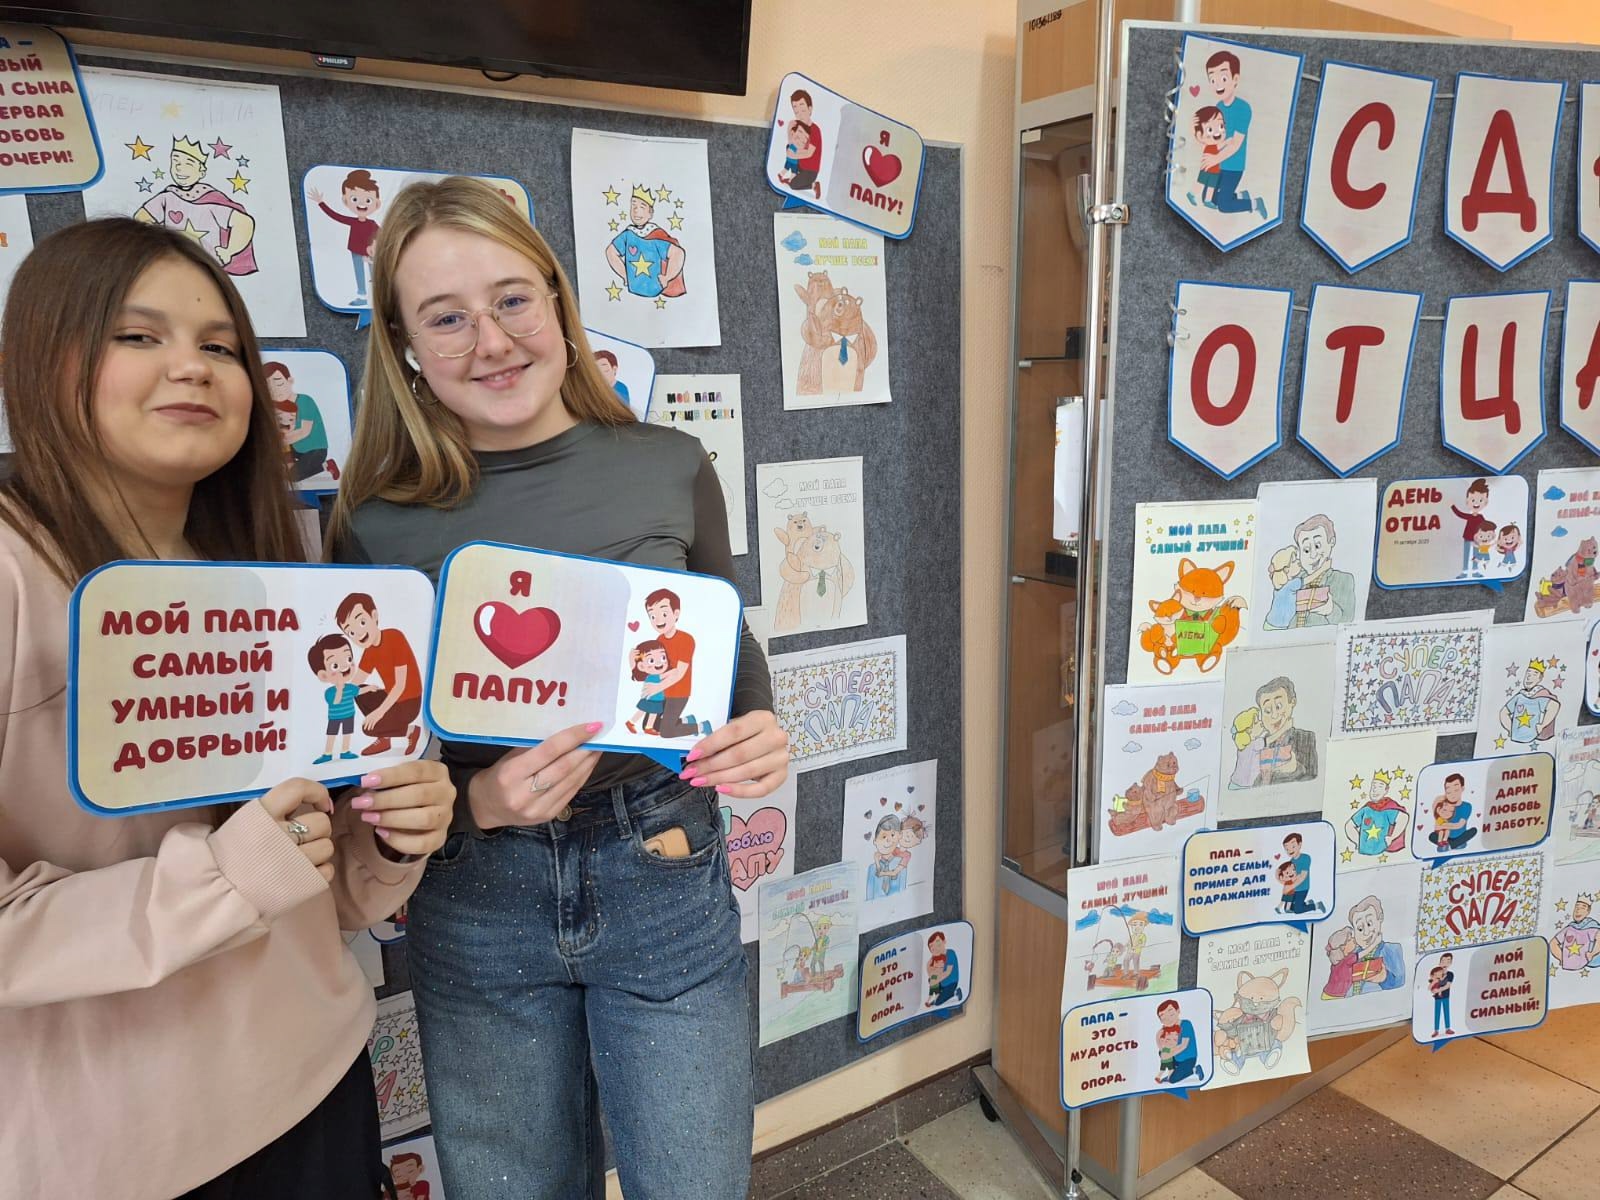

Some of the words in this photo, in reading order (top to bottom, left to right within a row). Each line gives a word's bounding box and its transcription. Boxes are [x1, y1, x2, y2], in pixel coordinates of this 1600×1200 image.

[0, 53, 43, 72] ВЫЙ
[12, 80, 74, 96] СЫНА
[0, 104, 64, 120] ЕРВАЯ
[880, 130, 891, 147] Я
[0, 150, 74, 166] ОЧЕРИ!
[1330, 102, 1396, 210] С
[850, 183, 903, 215] ПАПУ!
[694, 392, 722, 403] ПАПА
[1388, 488, 1443, 508] ДЕНЬ
[1169, 523, 1193, 536] МОЙ
[1198, 524, 1227, 535] ПАПА
[1385, 515, 1440, 533] ОТЦА
[1150, 540, 1191, 554] САМЫЙ
[1197, 538, 1248, 552] ЛУЧШИЙ!
[509, 570, 532, 597] Я
[101, 601, 189, 636] МОЙ
[204, 608, 299, 633] ПАПА
[133, 641, 273, 678] САМЫЙ
[1379, 644, 1458, 680] СУПЕР
[452, 672, 568, 707] ПАПУ!
[804, 671, 875, 709] СУПЕР
[1376, 669, 1456, 713] ПАПА
[111, 682, 253, 724] УМНЫЙ
[267, 689, 289, 712] И
[1143, 705, 1166, 718] МОЙ
[1170, 704, 1197, 715] ПАПА
[804, 694, 875, 741] ПАПА
[113, 721, 287, 773] ДОБРЫЙ!
[1501, 767, 1535, 781] ПАПА
[1495, 784, 1539, 800] ДАРИТ
[1489, 802, 1541, 816] ЛЮБОВЬ
[1482, 823, 1491, 833] И
[1494, 816, 1545, 832] ЗАБОТУ.
[1209, 848, 1241, 860] ПАПА
[730, 848, 785, 881] АПУ
[1189, 864, 1229, 877] ОПОРА
[1232, 860, 1272, 872] СЕМЬИ,
[1097, 877, 1118, 891] МОЙ
[1122, 873, 1148, 887] ПАПА
[1194, 877, 1239, 891] ПРИМЕР
[1242, 874, 1266, 886] ДЛЯ
[1448, 870, 1520, 904] СУПЕР
[1081, 893, 1118, 909] САМЫЙ
[1122, 884, 1168, 902] ЛУЧШИЙ!
[1188, 888, 1271, 907] ПОДРАЖАНИЯ!
[1445, 892, 1518, 935] ПАПА
[874, 948, 897, 965] ПАПА
[1228, 941, 1250, 955] МОЙ
[1494, 947, 1523, 965] МОЙ
[881, 962, 898, 976] ЭТО
[1489, 968, 1525, 982] ПАПА
[865, 970, 914, 999] МУДРОСТЬ
[1481, 981, 1531, 1000] САМЫЙ
[886, 992, 893, 1002] И
[871, 1002, 904, 1023] ОПОРА.
[1470, 997, 1540, 1019] СИЛЬНЫЙ!
[1081, 1012, 1114, 1027] ПАПА
[1091, 1027, 1116, 1040] ЭТО
[1070, 1040, 1138, 1062] МУДРОСТЬ
[1101, 1060, 1109, 1070] И
[1081, 1073, 1126, 1091] ОПОРА.
